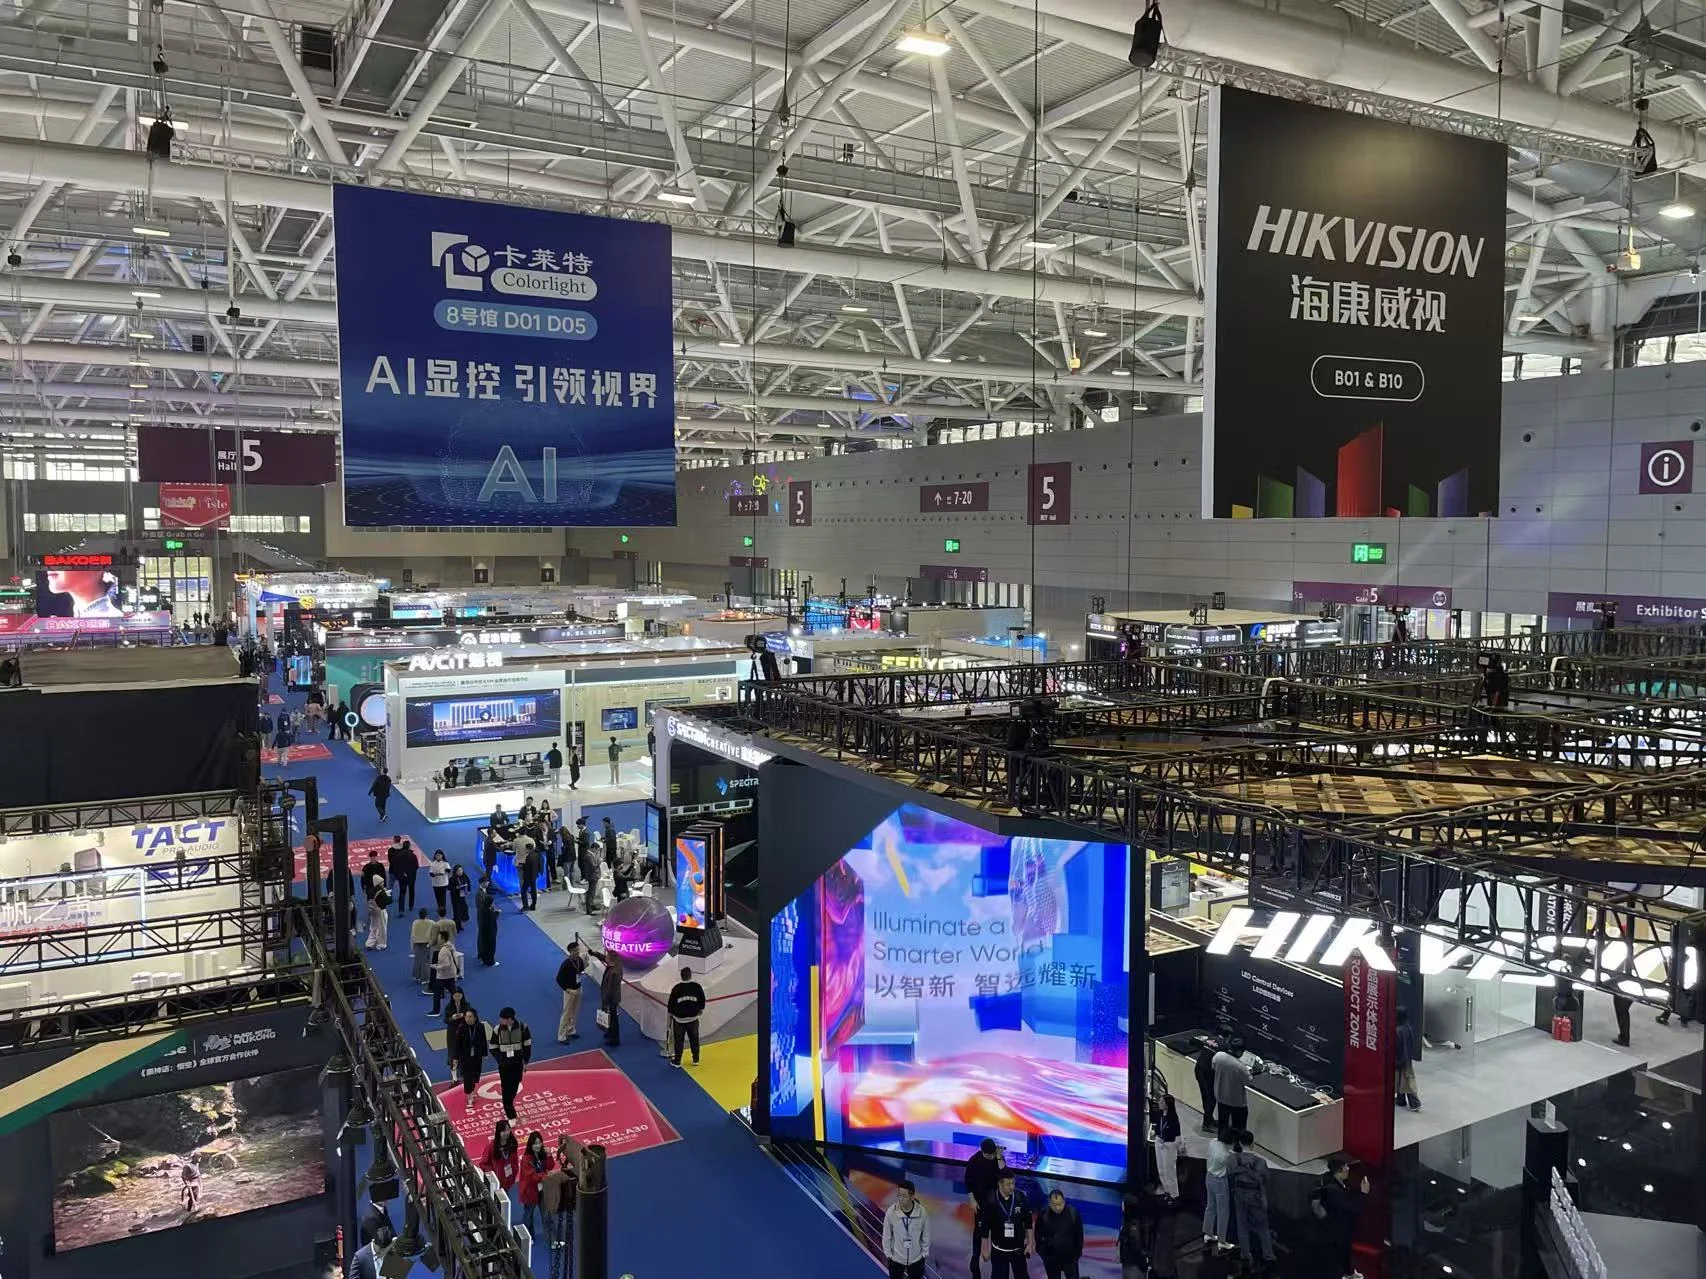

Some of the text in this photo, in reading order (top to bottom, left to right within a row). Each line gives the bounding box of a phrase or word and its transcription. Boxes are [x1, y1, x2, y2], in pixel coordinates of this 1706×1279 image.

[1246, 204, 1485, 278] HIKVISION
[494, 244, 594, 275] 卡莱特
[503, 272, 587, 296] Colorlight
[1290, 273, 1447, 333] 海康威视
[446, 306, 586, 335] 8号馆 D01 D05
[514, 363, 658, 409] 引领视界
[1334, 369, 1403, 390] B01 & B10
[217, 439, 263, 472] Hall 5
[475, 444, 558, 504] AI
[797, 490, 804, 516] 5
[953, 490, 973, 505] 7-20
[1042, 476, 1055, 510] 5
[953, 568, 958, 579] 6
[1370, 588, 1379, 603] 5
[1636, 604, 1699, 618] Exhibitor
[707, 736, 741, 758] CREATIVE
[131, 820, 226, 857] TACT
[186, 842, 219, 852] AUDIO
[873, 911, 1006, 937] Illuminate a
[605, 940, 653, 953] CREATIVE
[873, 940, 1045, 965] Smarter World
[874, 973, 955, 1000] 以智新
[1241, 970, 1252, 980] LED
[233, 1031, 276, 1045] WUKONG
[1350, 1012, 1360, 1049] ZONE
